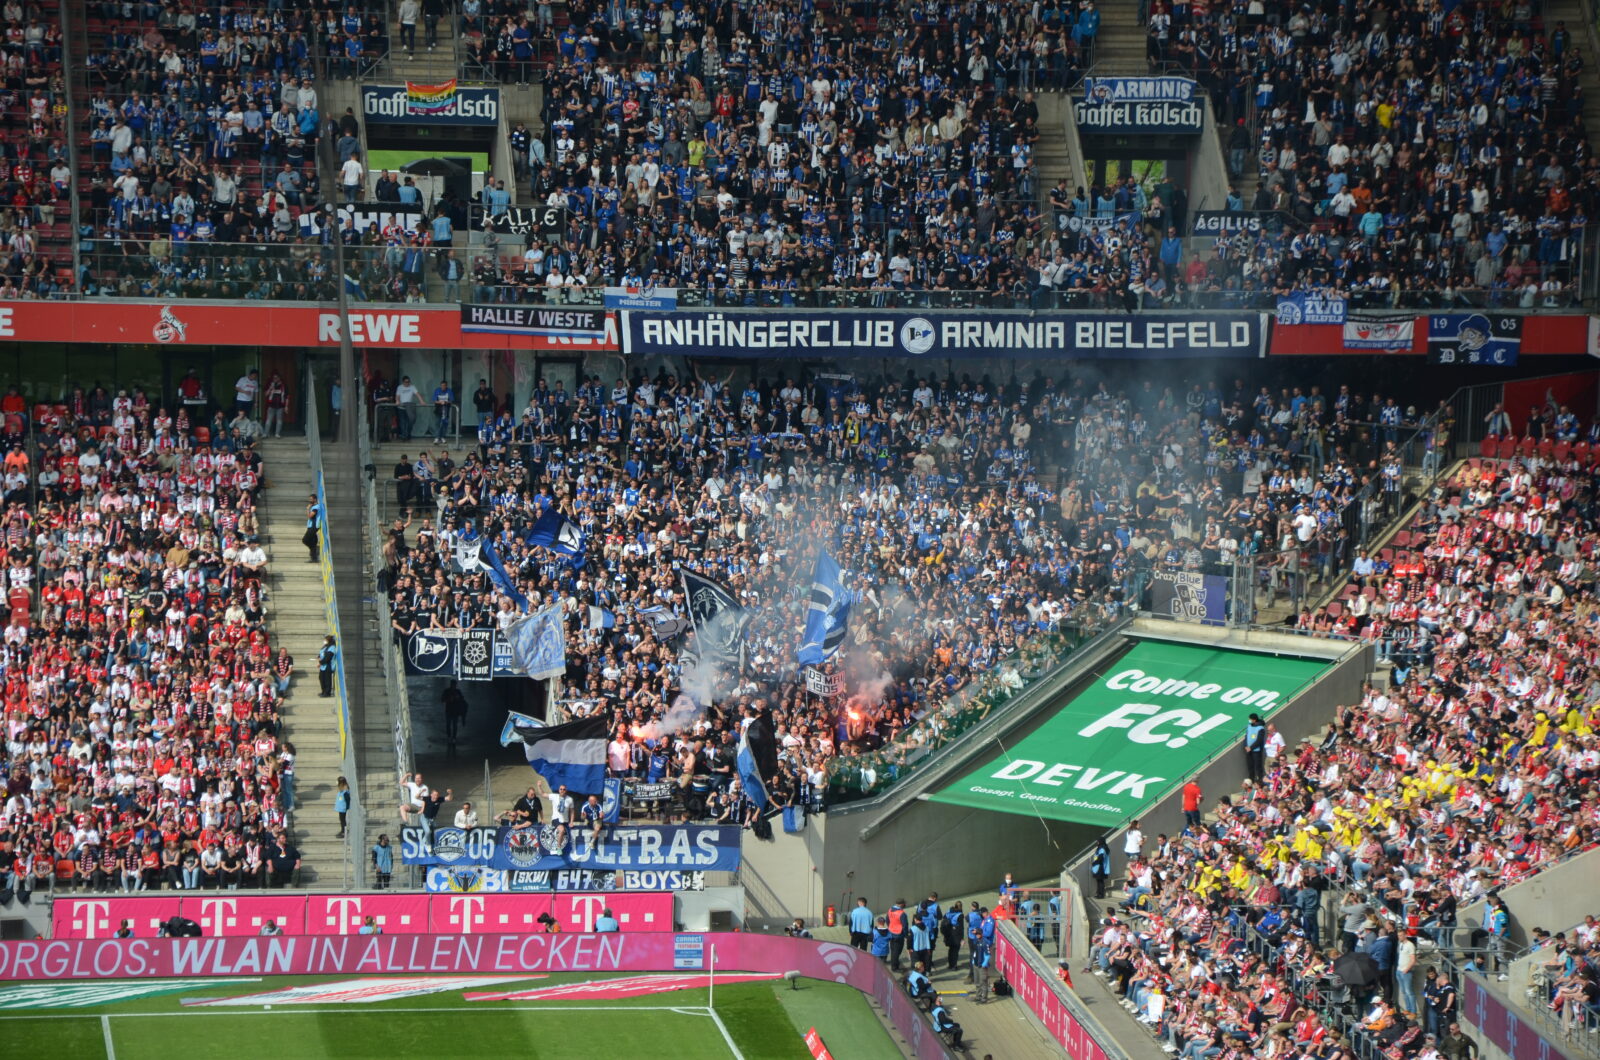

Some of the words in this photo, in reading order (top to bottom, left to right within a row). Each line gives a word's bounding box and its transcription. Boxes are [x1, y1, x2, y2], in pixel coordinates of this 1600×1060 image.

[1114, 81, 1191, 99] ARMINIS
[365, 91, 424, 117] Gaff
[429, 93, 496, 120] lsch
[1074, 102, 1132, 127] Gaffel
[1136, 102, 1201, 128] Kölsch
[481, 208, 558, 226] KALLE
[510, 226, 531, 235] TA
[319, 313, 421, 343] REWE
[472, 307, 524, 326] HALLE
[528, 311, 534, 326] /
[538, 311, 596, 329] WESTF.
[643, 314, 895, 348] ANHÄNGERCLUB
[941, 321, 1065, 349] ARMINIA
[1075, 321, 1250, 349] BIELEFELD
[1433, 318, 1448, 329] 19
[1501, 319, 1517, 330] 05
[1154, 571, 1177, 583] Crazy
[1179, 573, 1201, 584] Blue
[1105, 669, 1222, 699] Come
[1220, 686, 1281, 711] on,
[1078, 703, 1233, 749] FC!
[990, 759, 1167, 799] DEVK
[970, 786, 1015, 798] Gesagt.
[1019, 792, 1059, 804] Getan.
[1063, 798, 1123, 814] Geholfen.
[468, 828, 496, 860] 05
[569, 829, 720, 865] ULTRAS
[556, 871, 593, 890] 647
[625, 871, 681, 890] BOYS
[0, 939, 160, 978] ORGLOS:
[171, 938, 296, 974] WLAN
[306, 936, 349, 972] IN
[355, 935, 484, 971] ALLEN
[494, 934, 625, 970] ECKEN
